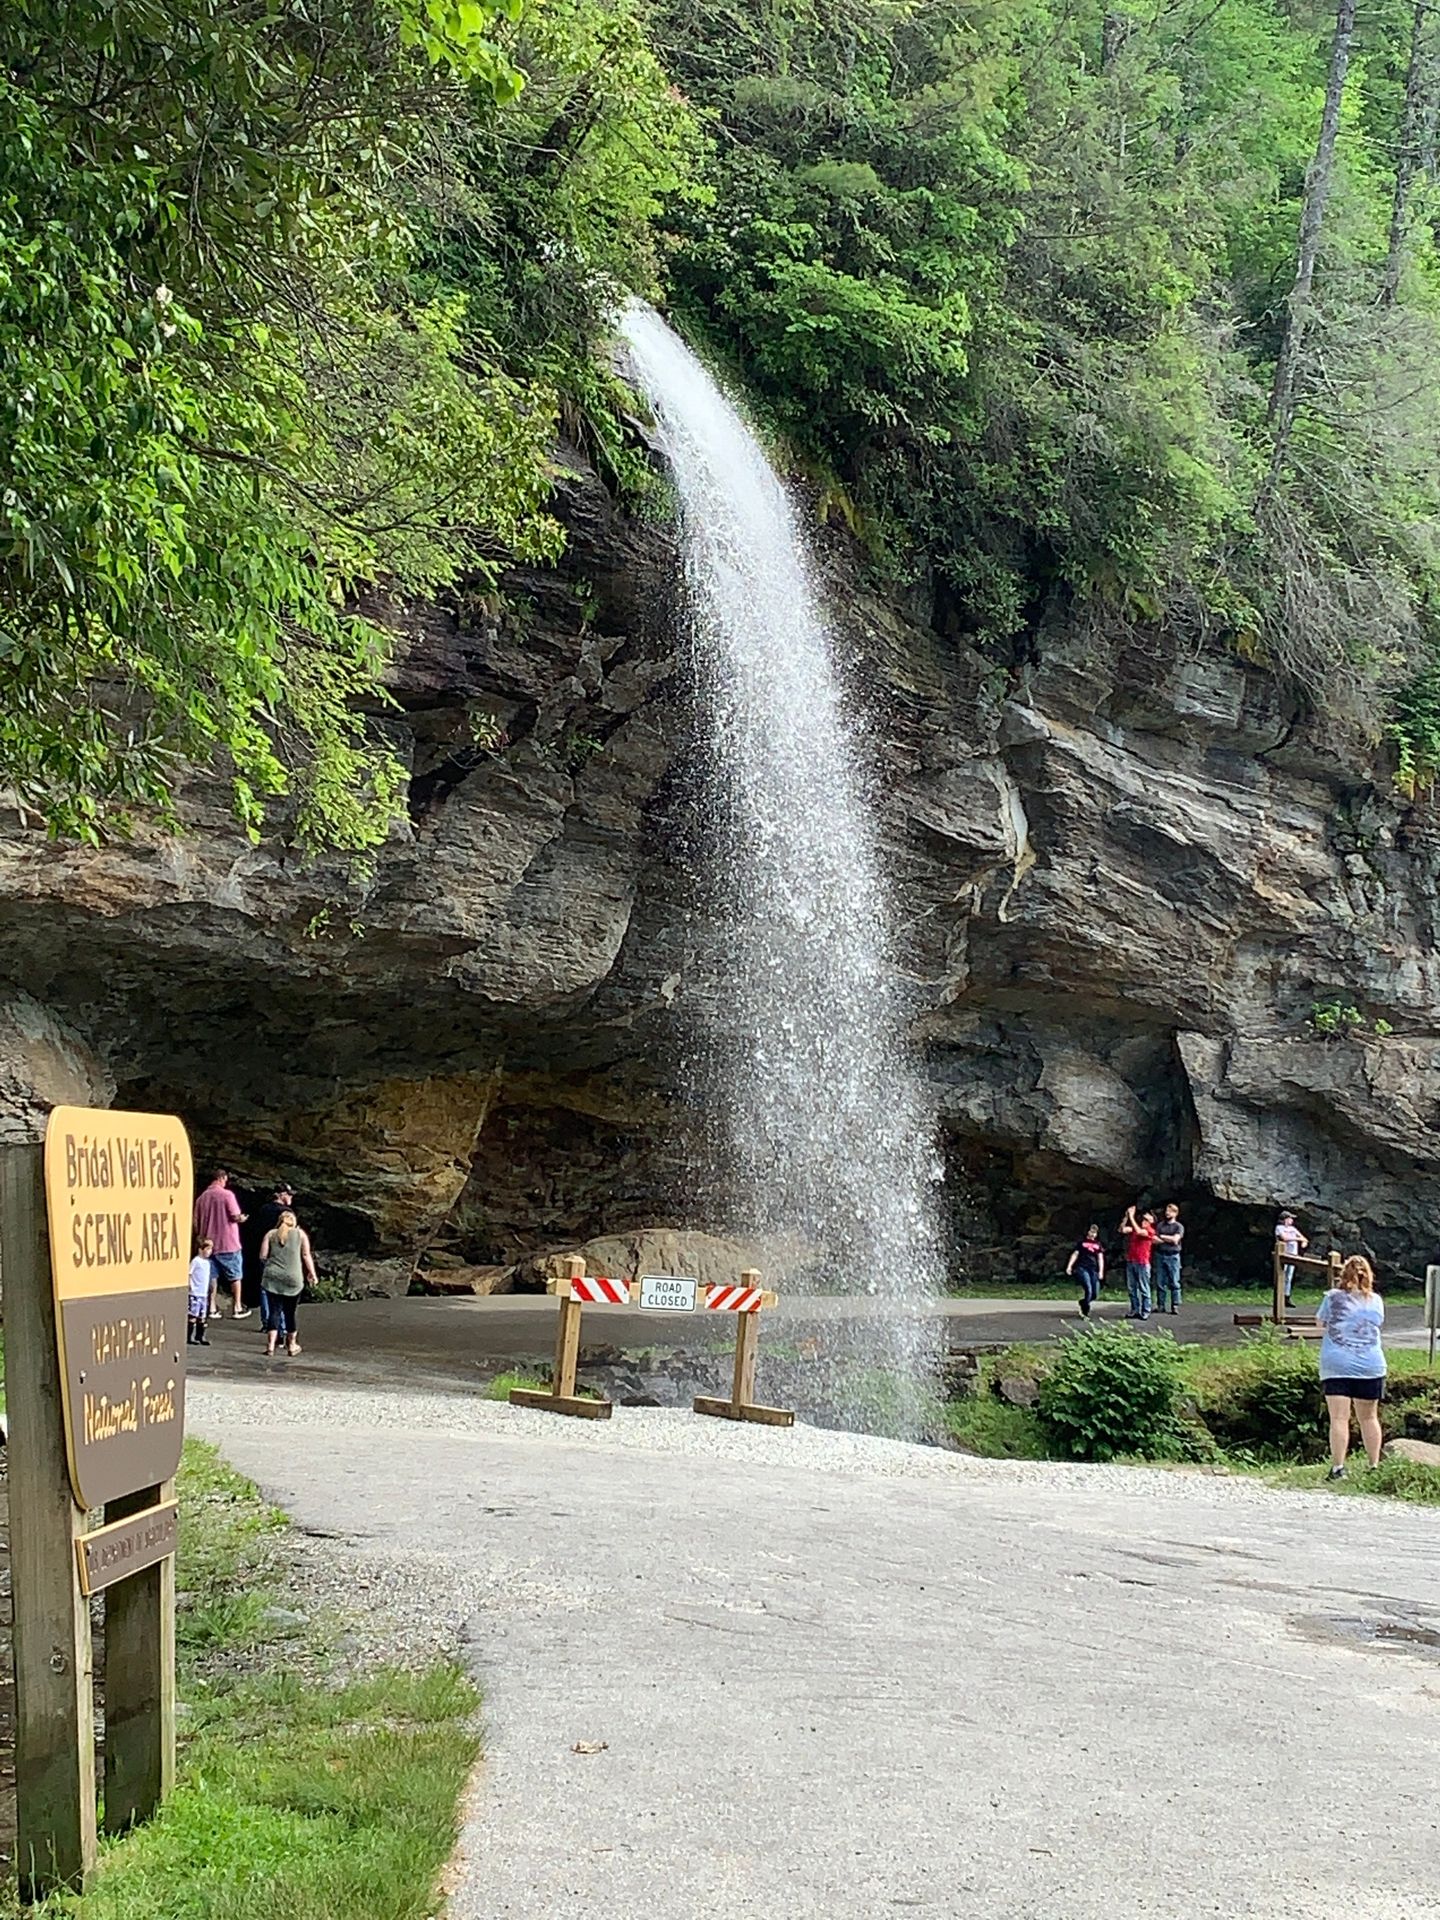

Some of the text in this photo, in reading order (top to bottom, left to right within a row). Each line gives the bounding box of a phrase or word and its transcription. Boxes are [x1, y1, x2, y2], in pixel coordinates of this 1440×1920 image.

[65, 1134, 181, 1189] Bridal Veil Falls
[72, 1212, 180, 1268] SCENIC AREA
[648, 1294, 688, 1307] CLOSED
[655, 1282, 682, 1293] ROAD
[84, 1377, 175, 1445] National Forest
